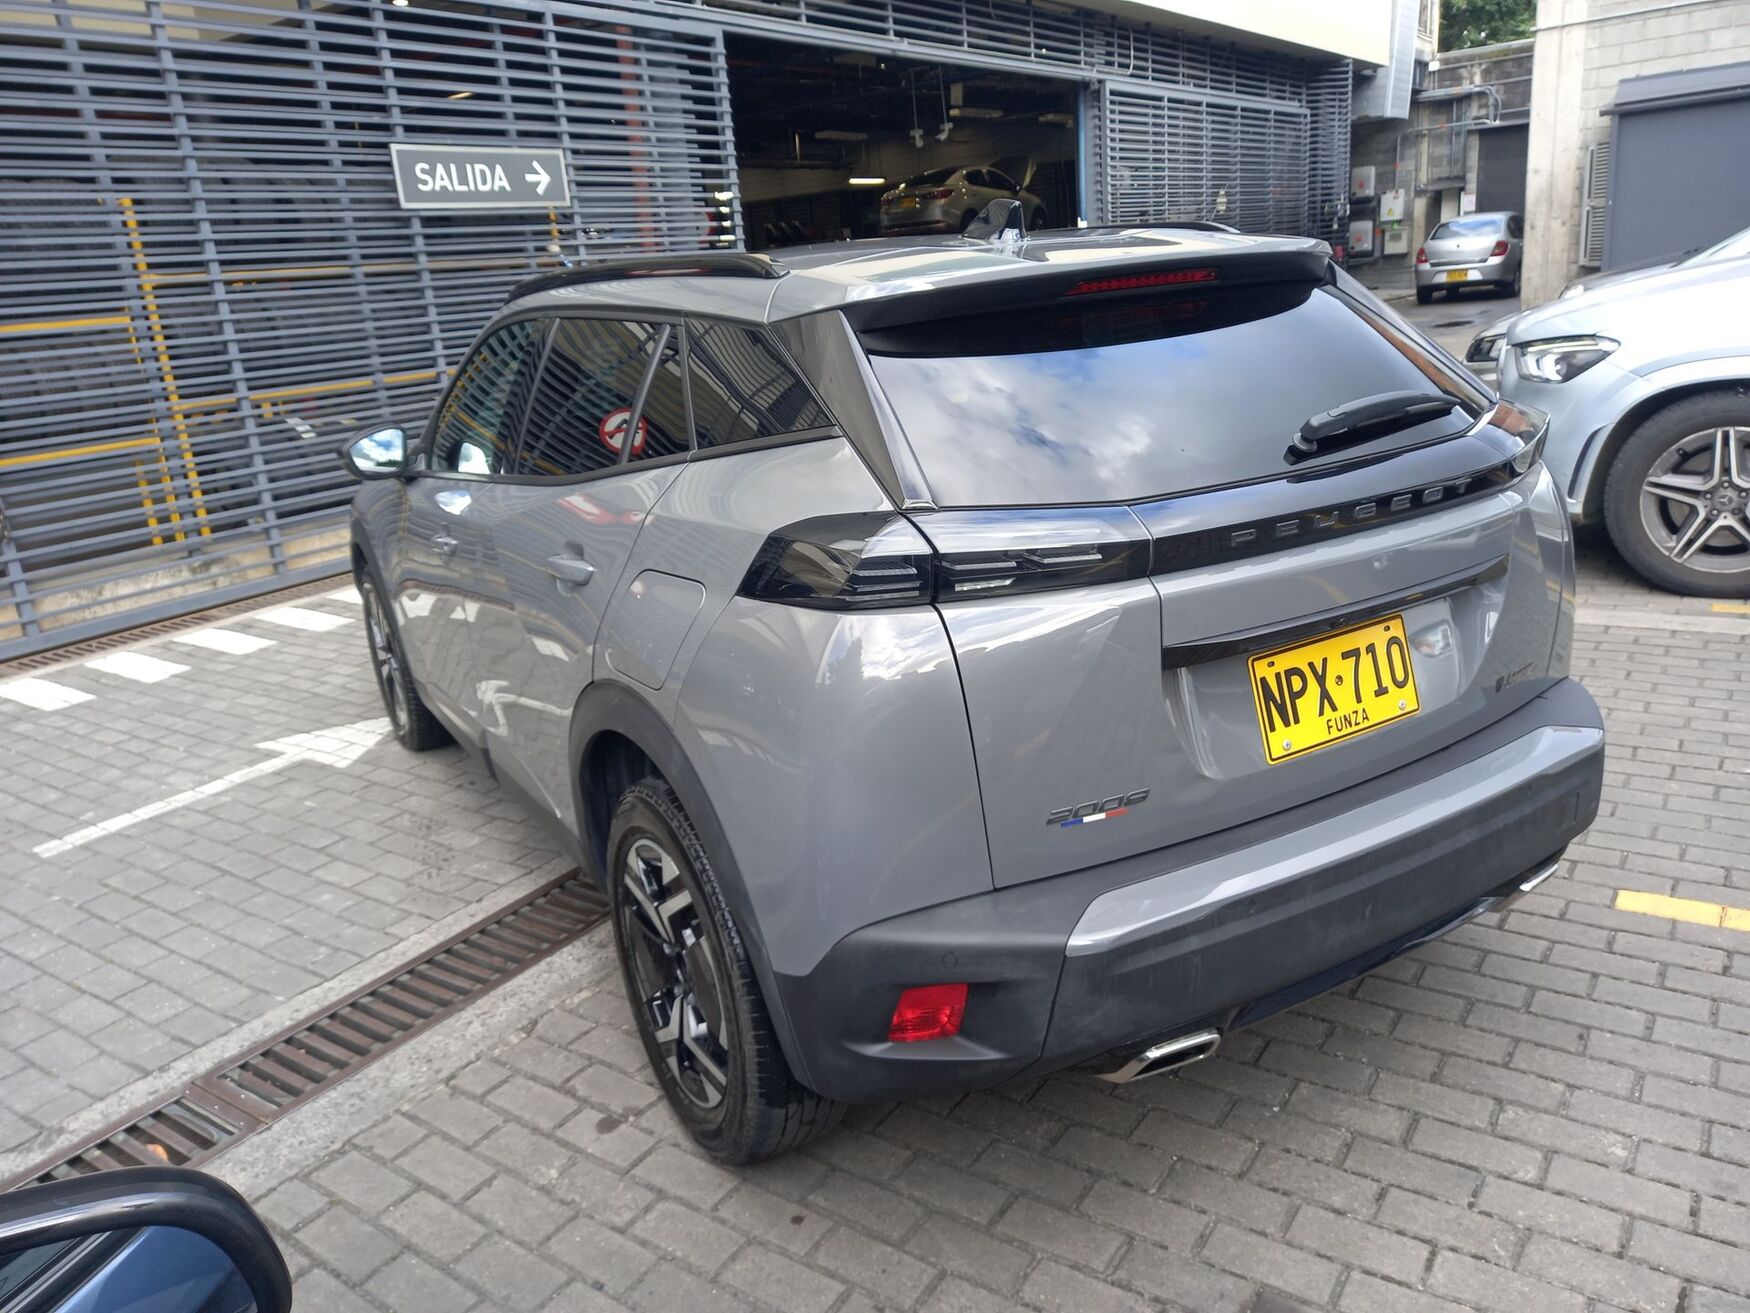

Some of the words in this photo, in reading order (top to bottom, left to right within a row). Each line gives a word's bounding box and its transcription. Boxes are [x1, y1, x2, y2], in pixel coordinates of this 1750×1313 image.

[414, 162, 512, 192] SALIDA
[1230, 477, 1473, 547] PEUGEOT
[1326, 707, 1370, 735] FUNZA
[1046, 787, 1150, 825] 2008
